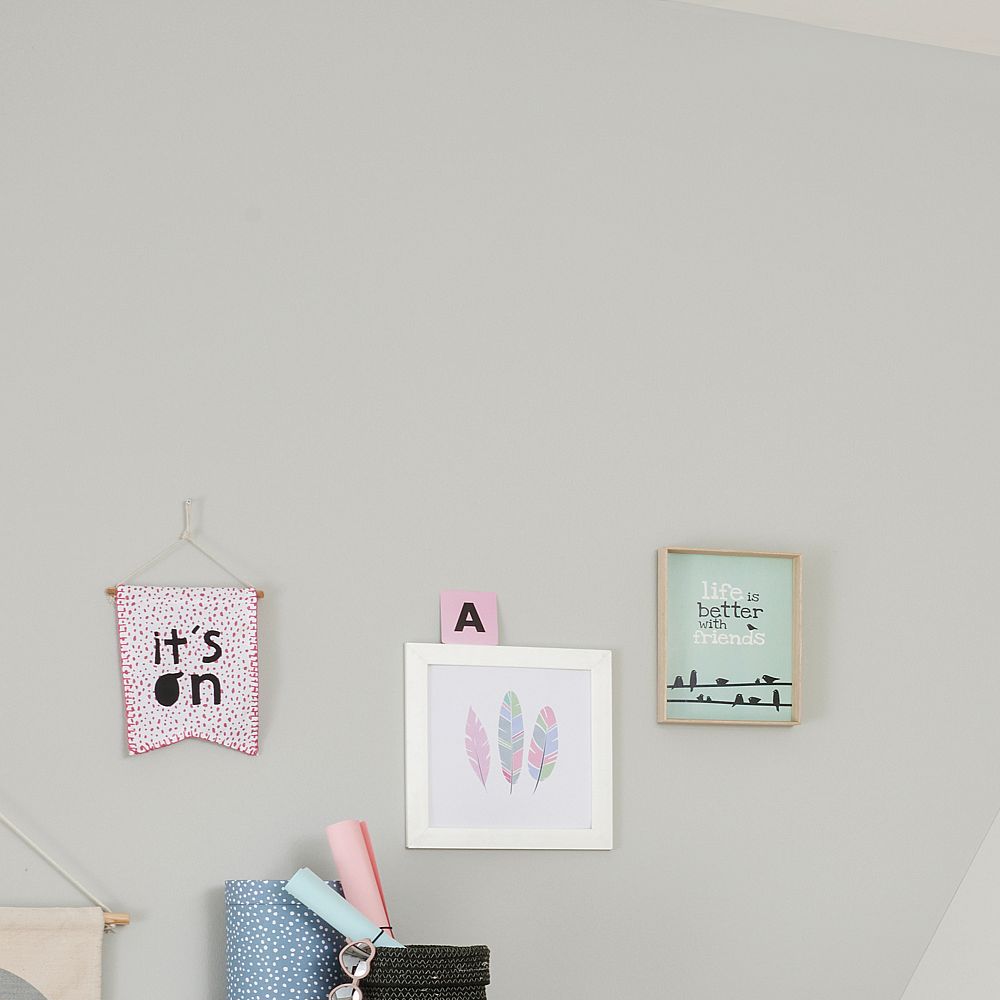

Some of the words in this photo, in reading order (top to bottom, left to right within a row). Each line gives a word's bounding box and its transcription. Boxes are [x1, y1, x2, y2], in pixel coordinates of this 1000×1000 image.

[702, 581, 743, 600] life
[747, 592, 760, 602] is
[454, 602, 486, 633] A
[697, 601, 764, 619] better
[699, 619, 727, 629] with
[693, 630, 765, 645] friends
[154, 671, 222, 707] on
